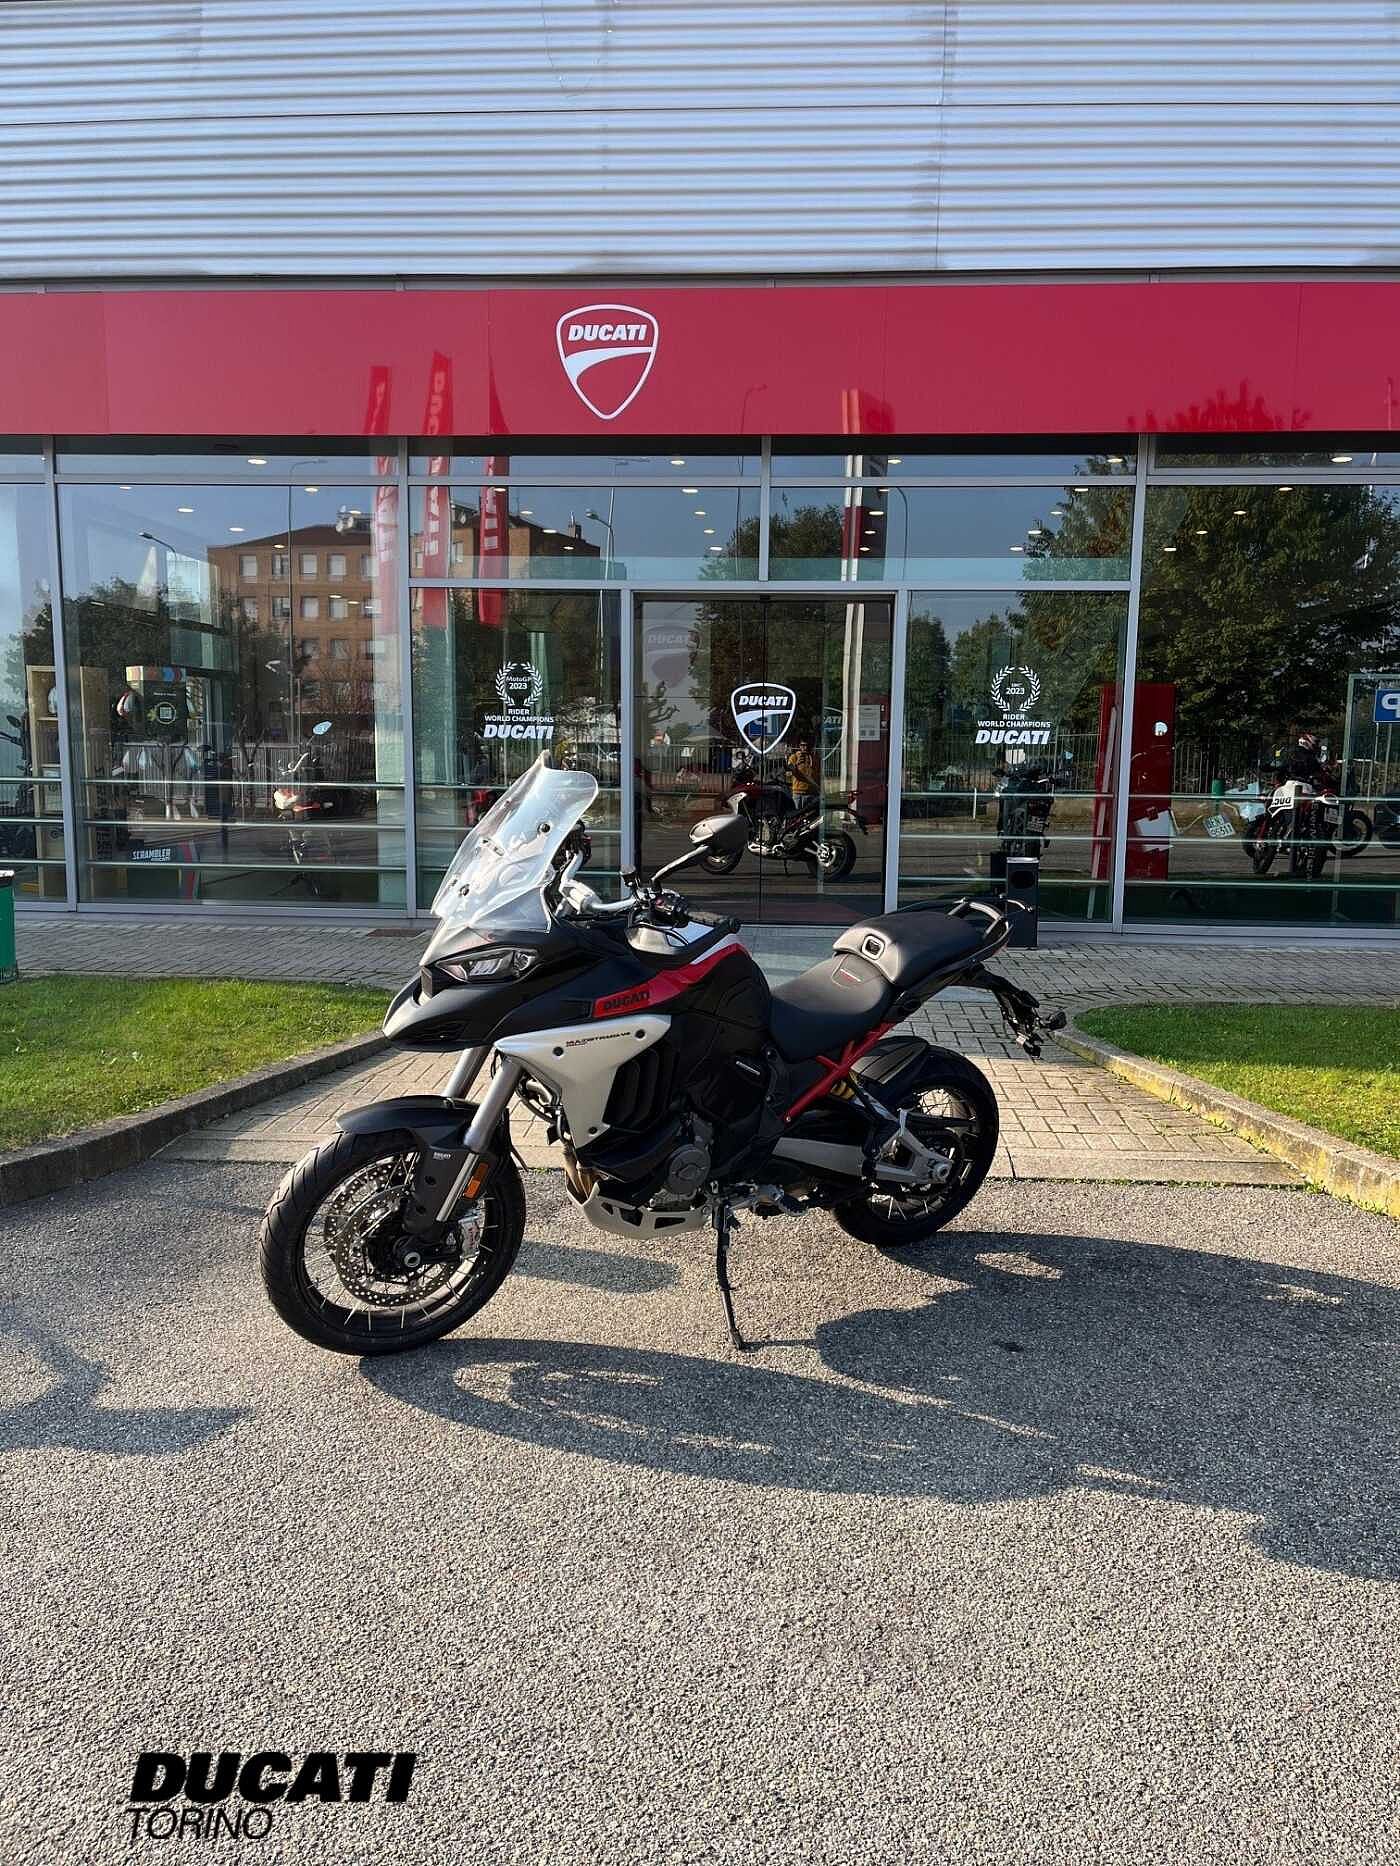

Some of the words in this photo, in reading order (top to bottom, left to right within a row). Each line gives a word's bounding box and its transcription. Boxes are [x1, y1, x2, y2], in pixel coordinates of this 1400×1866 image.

[568, 324, 648, 341] DUCATI
[1006, 687, 1024, 695] 2023
[739, 695, 788, 706] DUCATI
[512, 715, 554, 723] CHAMPIONS
[977, 720, 1005, 728] WORLD
[1006, 720, 1051, 728] CHAMPIONS
[483, 724, 554, 739] DUCATI
[975, 729, 1051, 745] DUCATI
[132, 848, 171, 860] SCRAMBLER
[604, 991, 649, 1009] DUCATI
